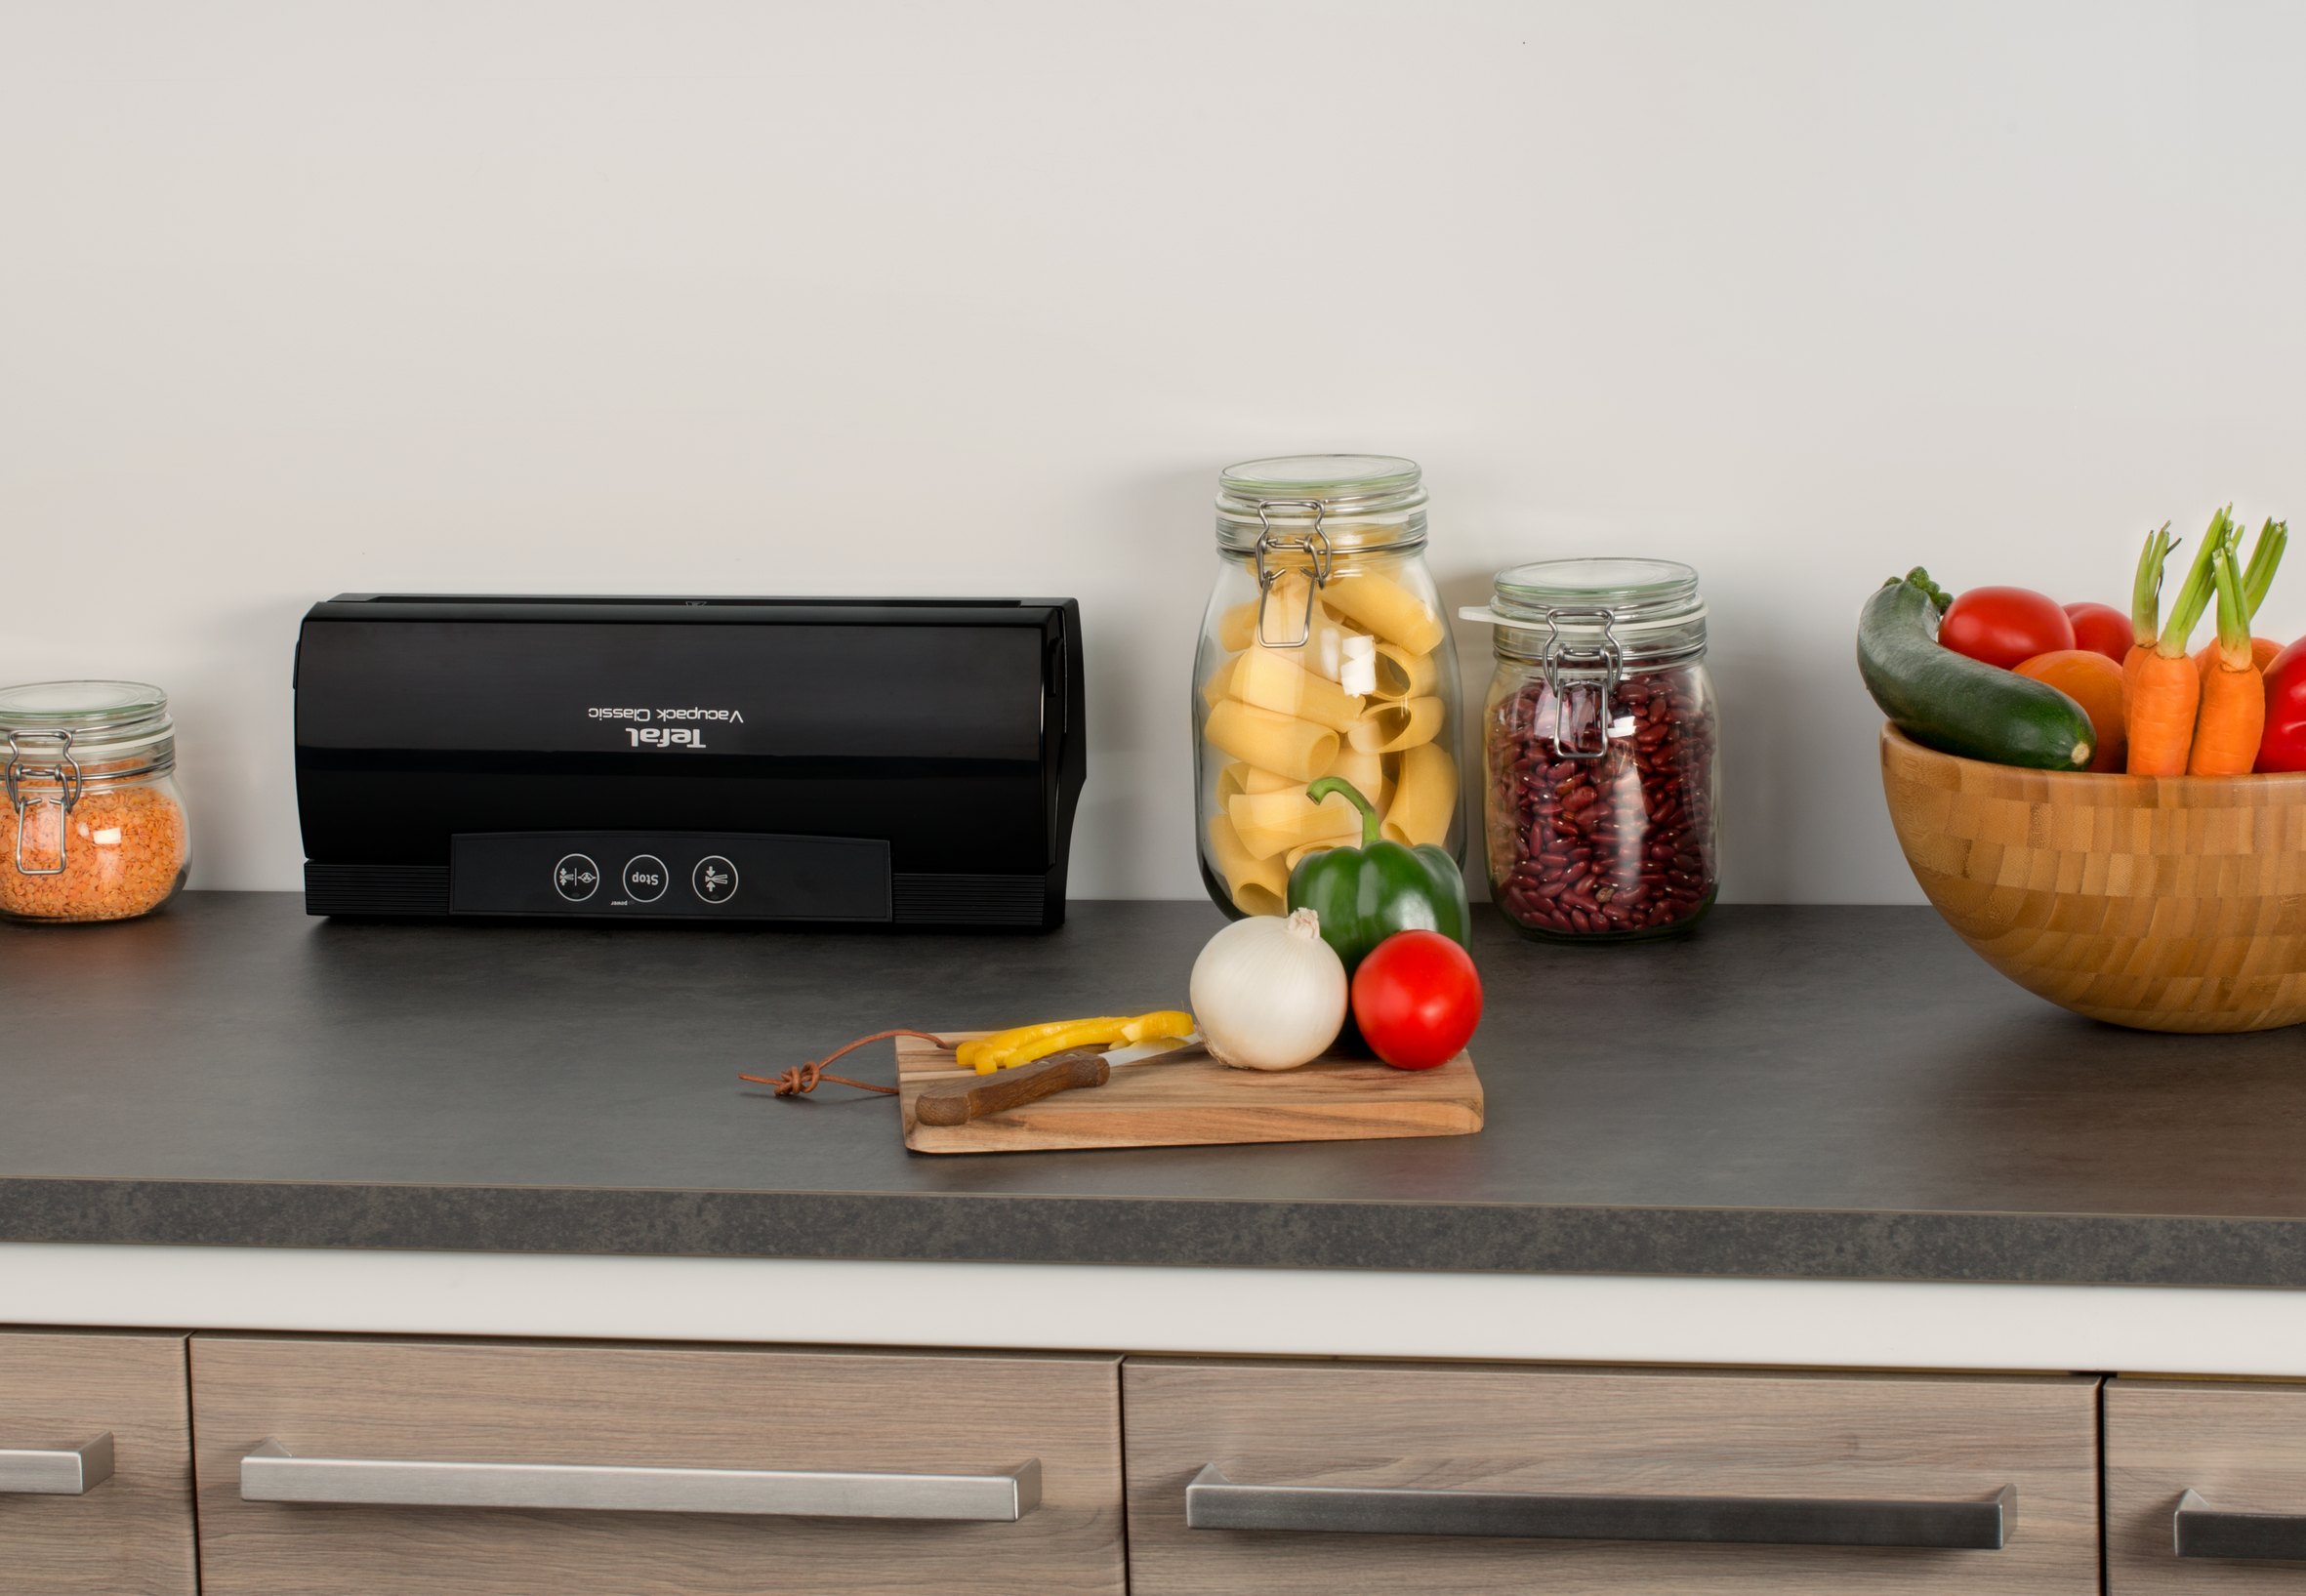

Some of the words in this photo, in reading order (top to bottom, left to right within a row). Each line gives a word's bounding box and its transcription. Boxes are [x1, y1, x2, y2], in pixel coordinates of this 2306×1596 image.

[588, 708, 651, 722] Classic
[656, 707, 744, 723] Vacupack
[625, 727, 707, 749] Tefal
[632, 871, 659, 885] Stop
